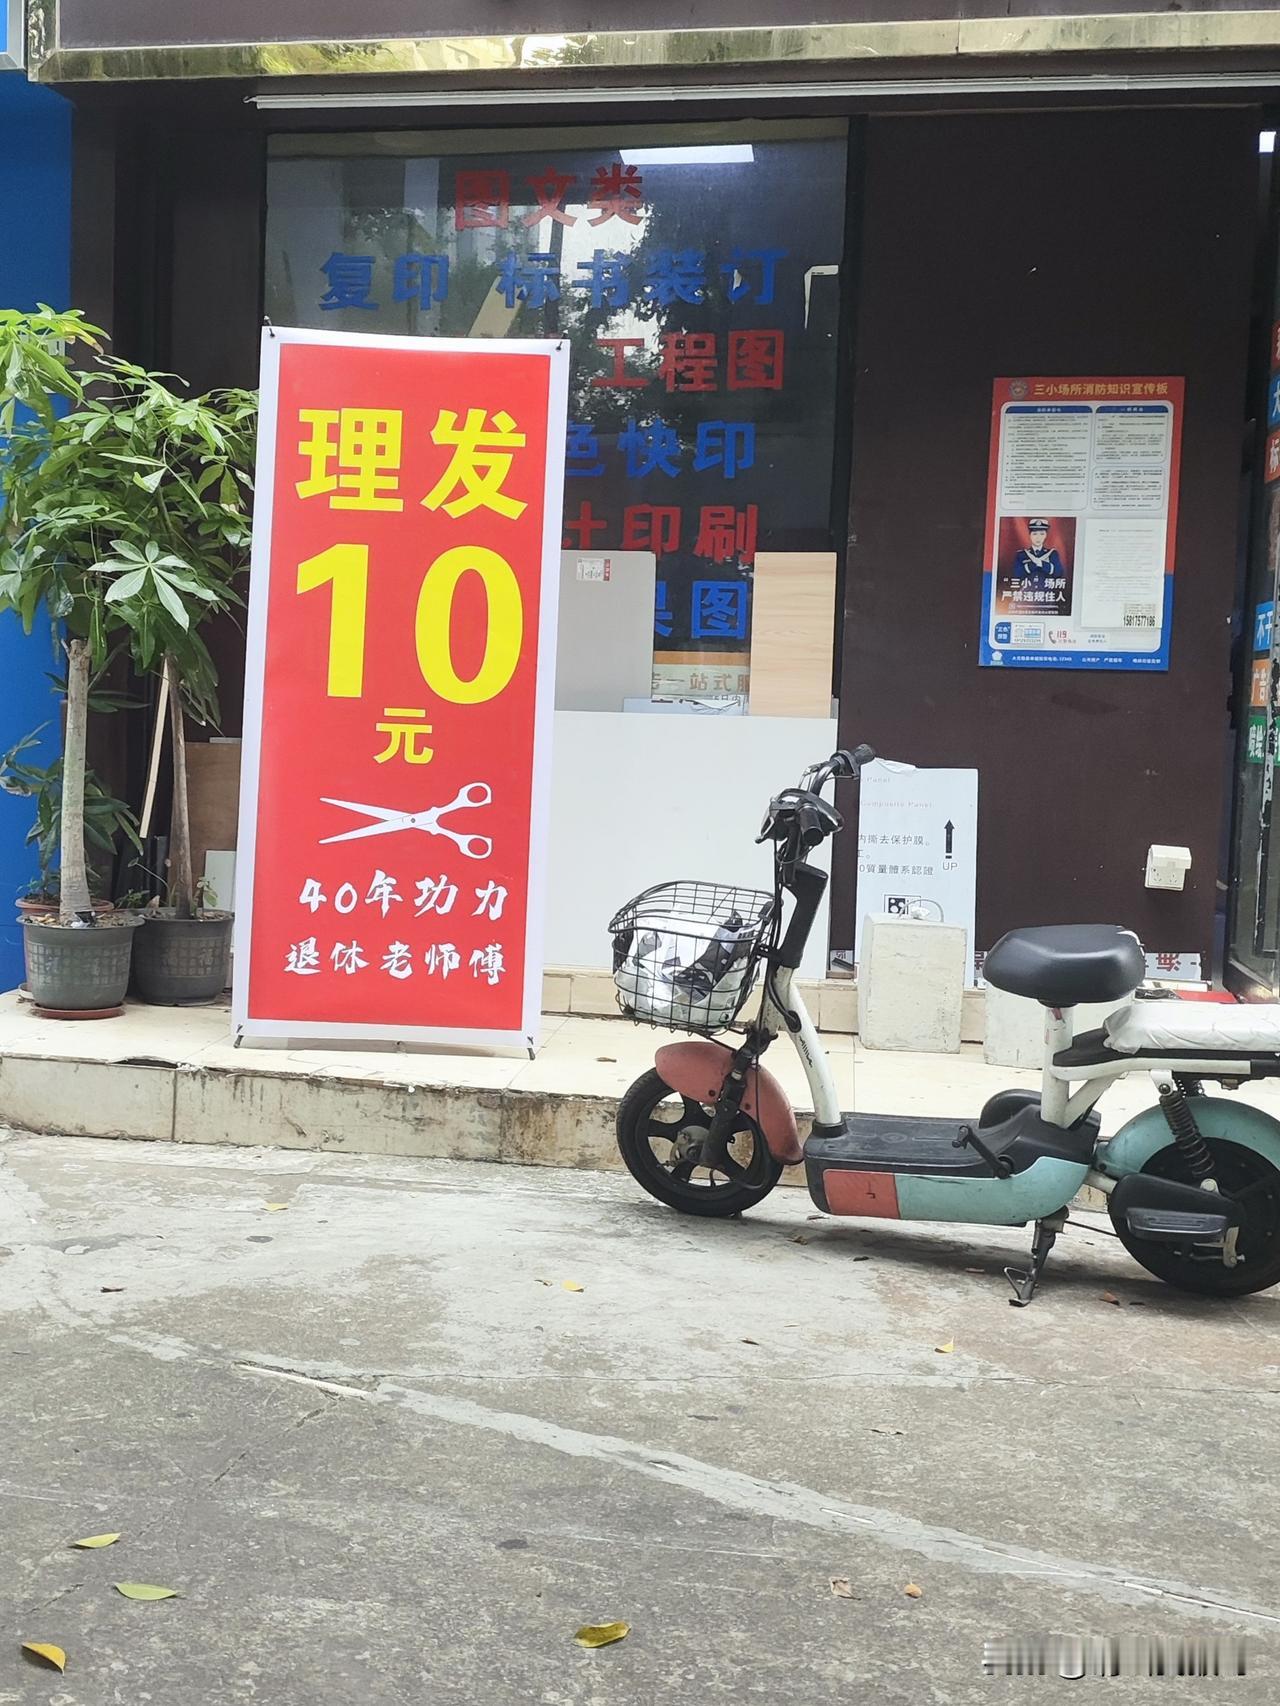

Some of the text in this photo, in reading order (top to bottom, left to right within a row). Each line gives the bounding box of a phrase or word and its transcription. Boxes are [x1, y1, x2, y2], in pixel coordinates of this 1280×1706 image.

[454, 162, 645, 232] 图文类
[319, 247, 788, 311] 复印 标书装订
[592, 329, 784, 393] 工程图
[1033, 382, 1169, 396] 三小场所消防知识宣传板
[295, 407, 528, 521] 理发
[296, 542, 524, 706] 10
[1001, 590, 1066, 602] 严禁违规住人
[373, 707, 434, 765] 元
[298, 869, 509, 921] 40年功力
[942, 862, 958, 871] UP
[283, 936, 507, 986] 退休老师傅
